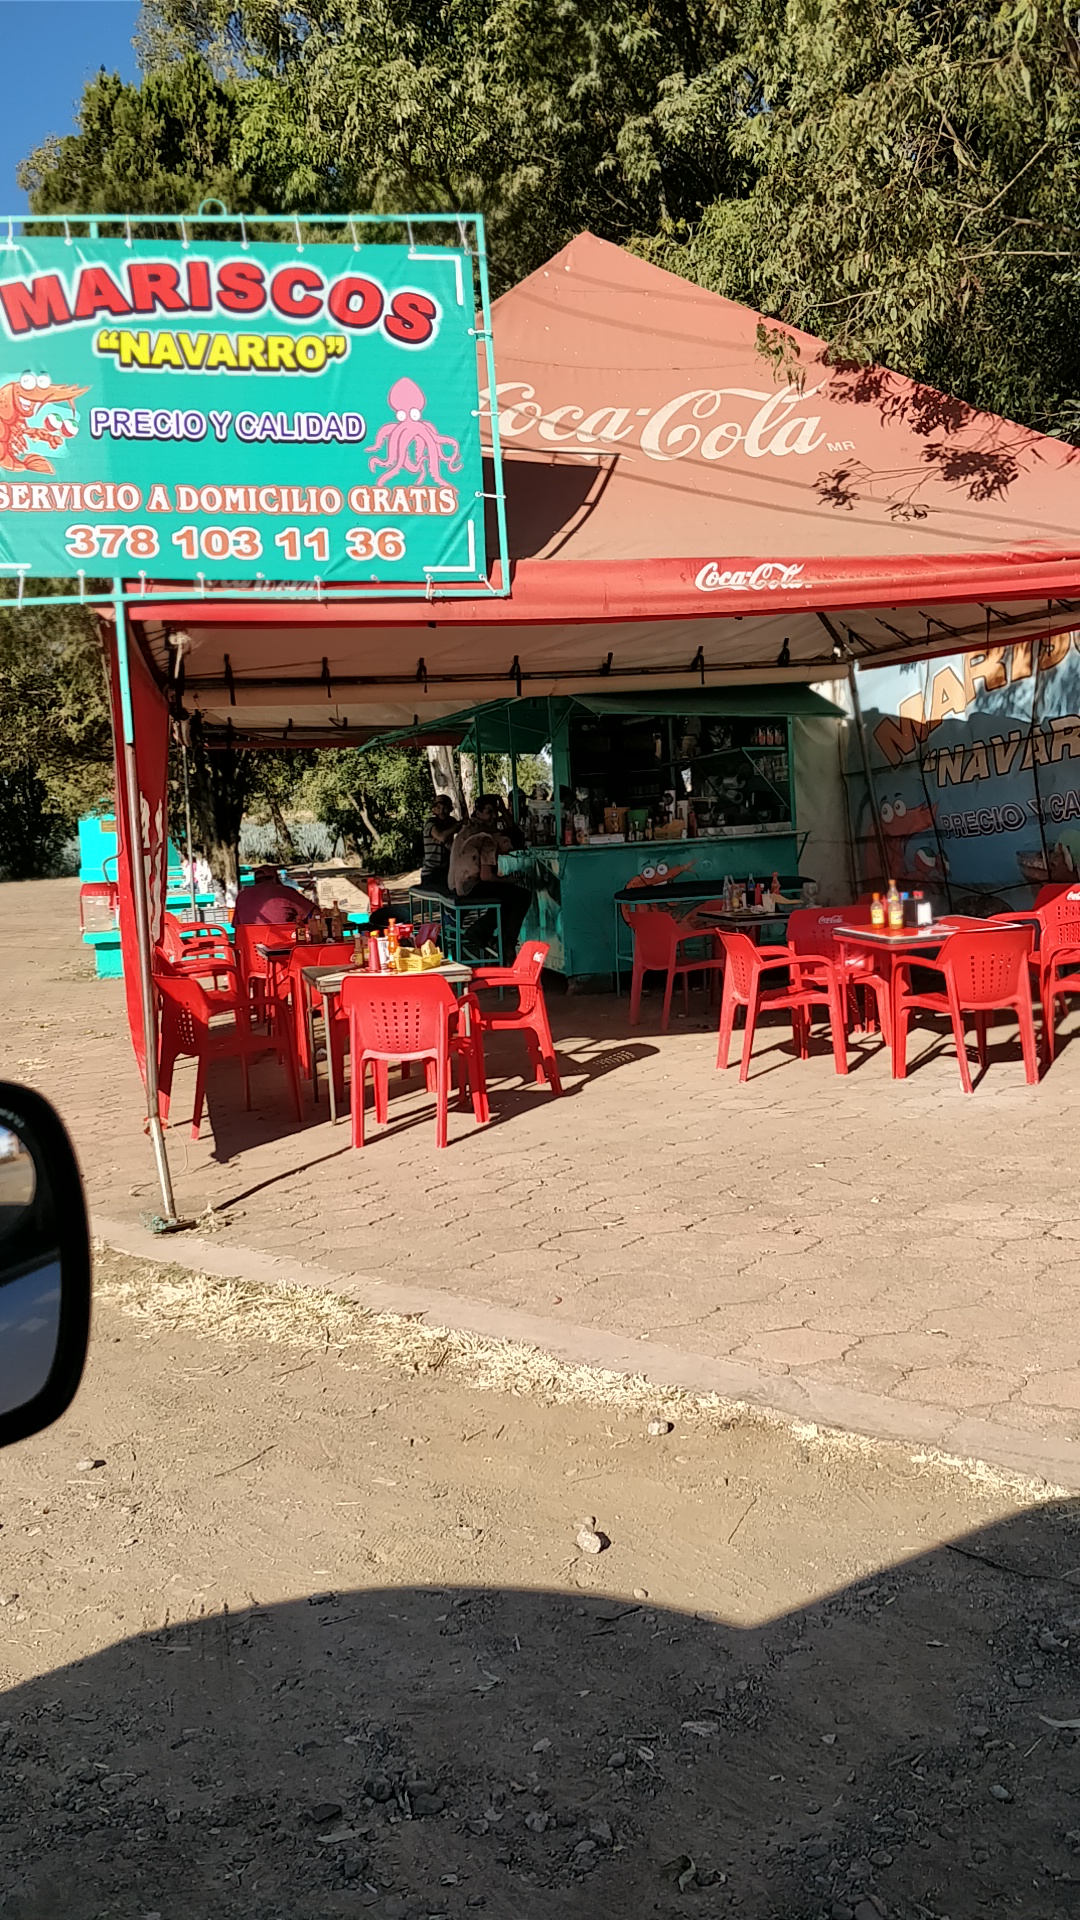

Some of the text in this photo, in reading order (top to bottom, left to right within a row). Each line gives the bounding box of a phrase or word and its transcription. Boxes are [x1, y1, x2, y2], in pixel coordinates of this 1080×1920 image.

[1, 261, 437, 343] MARISCOS
[97, 331, 347, 372] “NAVARRO”
[91, 409, 366, 443] PRECIO Y CALIDAD
[826, 440, 856, 453] MR
[0, 482, 459, 516] SERVICIO A DOMICILIO GRATIS
[65, 524, 406, 562] 378 103 11 36
[695, 562, 805, 592] Coca-Cola
[873, 631, 1080, 769] MARIS
[939, 790, 1080, 839] PRECIO Y CA
